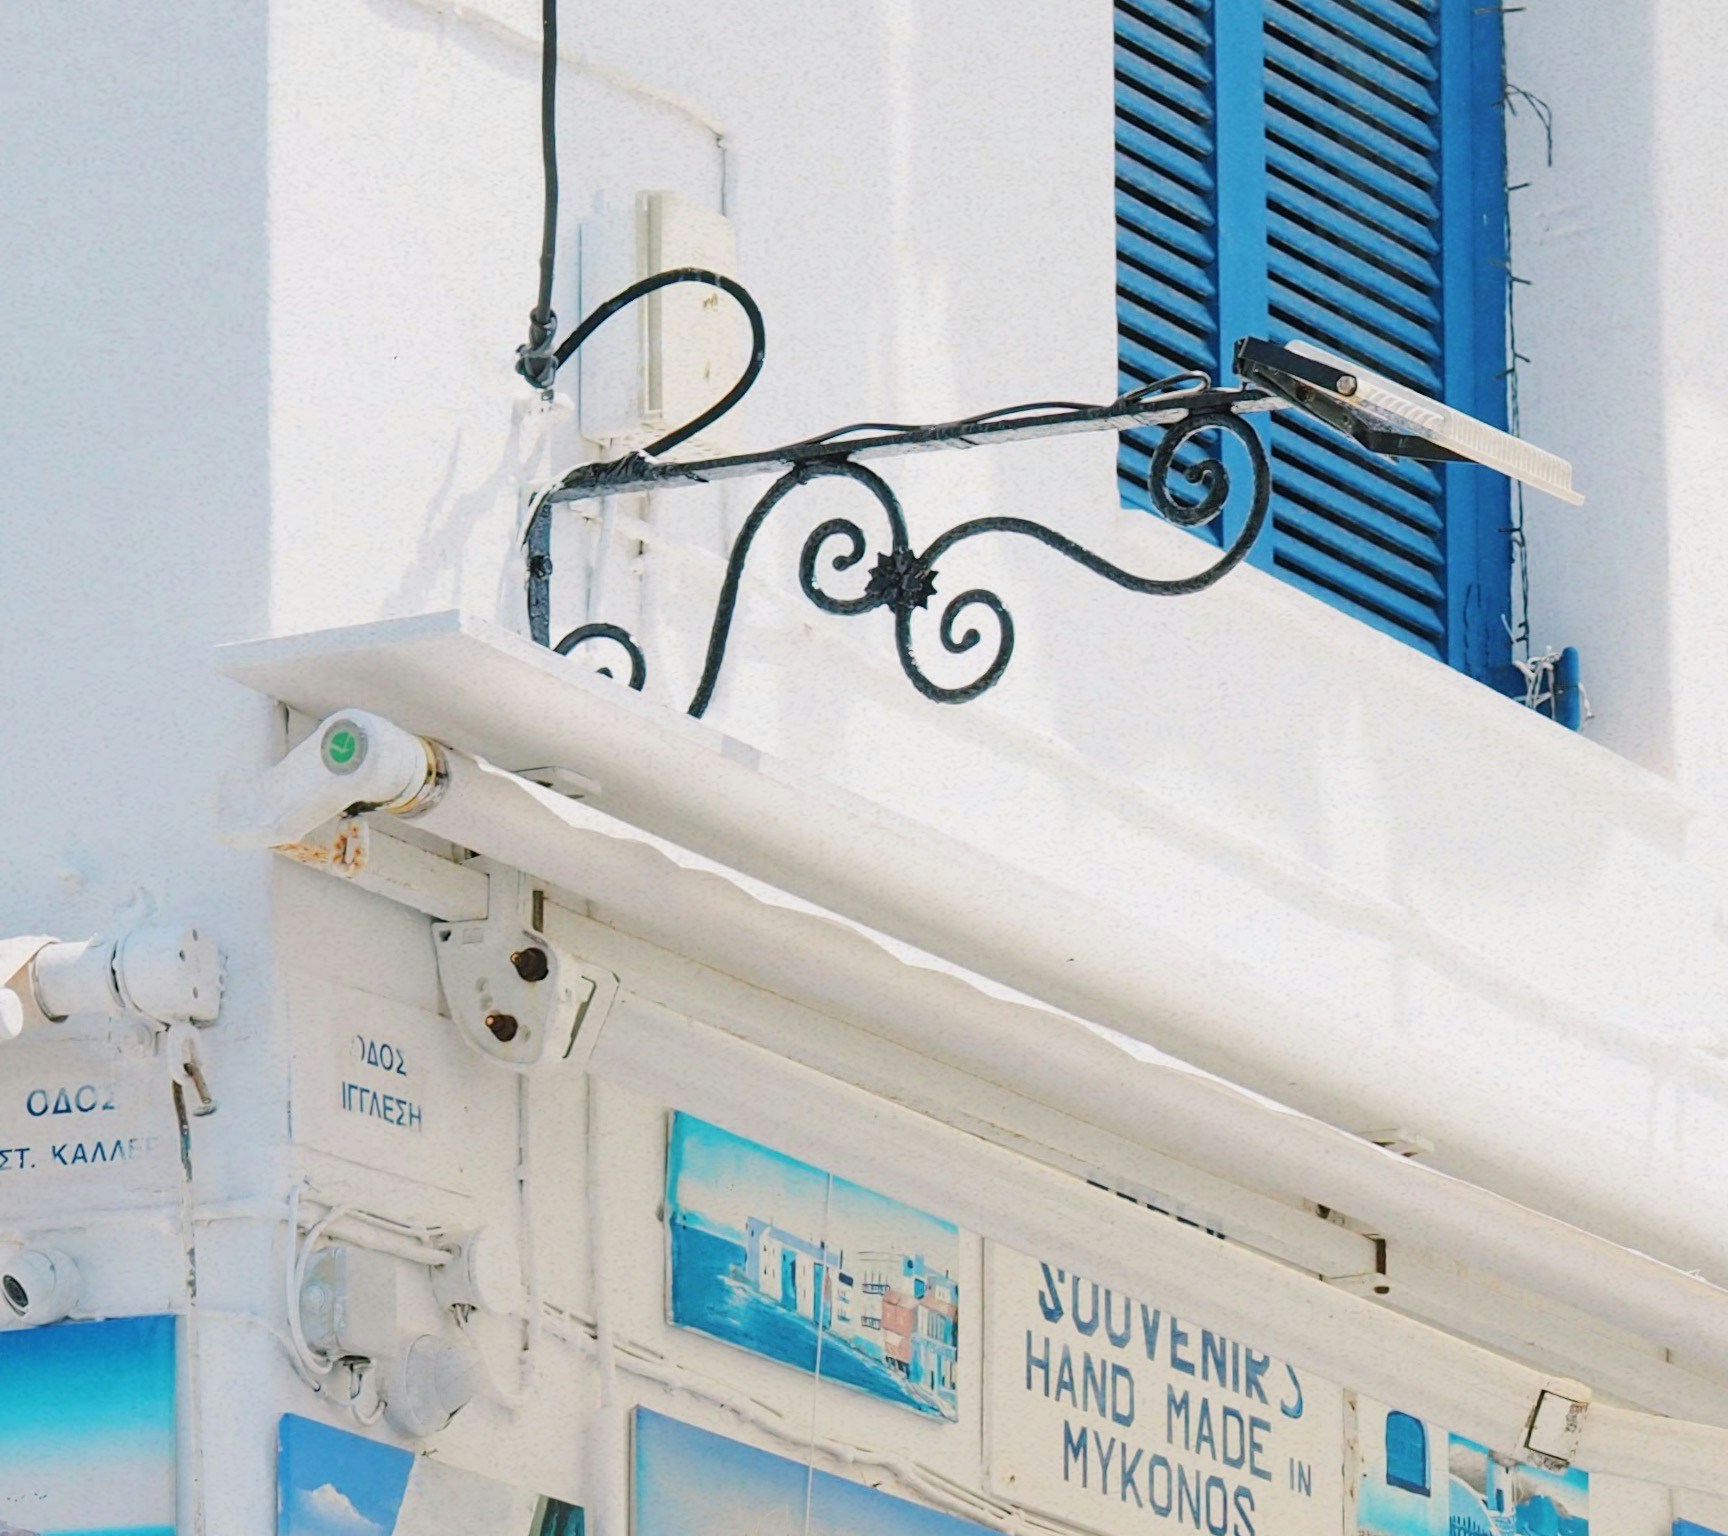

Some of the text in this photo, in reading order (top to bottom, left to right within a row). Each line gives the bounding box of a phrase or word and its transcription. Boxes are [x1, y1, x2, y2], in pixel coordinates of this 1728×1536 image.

[1026, 1329, 1312, 1497] HAND MADE IN
[1038, 1260, 1304, 1420] SOUVENIRS
